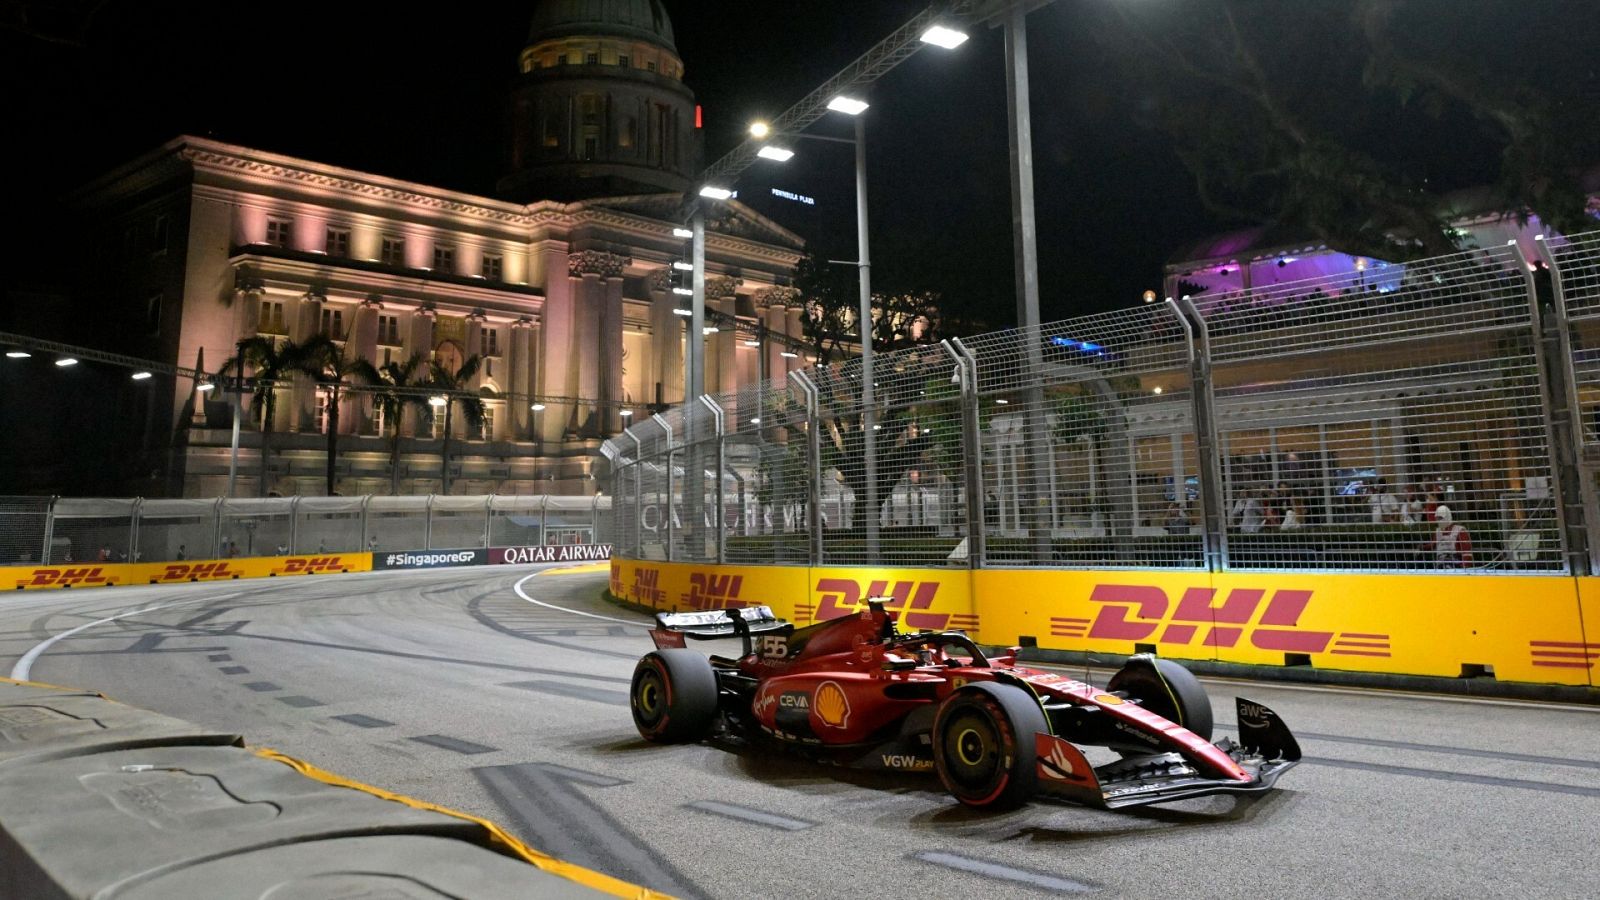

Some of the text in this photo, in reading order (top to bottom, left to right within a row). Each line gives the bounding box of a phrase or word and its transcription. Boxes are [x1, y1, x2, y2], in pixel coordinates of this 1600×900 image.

[386, 551, 475, 566] #SingaporeGP
[504, 545, 612, 563] QATAR AIRWAY
[163, 563, 232, 580] DHL
[284, 557, 344, 573] DHL
[31, 568, 106, 585] DHL
[634, 568, 660, 601] DHL
[689, 572, 747, 609] DHL
[814, 578, 950, 630] DHL
[1087, 584, 1334, 652] DHL
[763, 635, 788, 658] 55
[1240, 703, 1268, 719] aws
[881, 755, 915, 768] VGW
